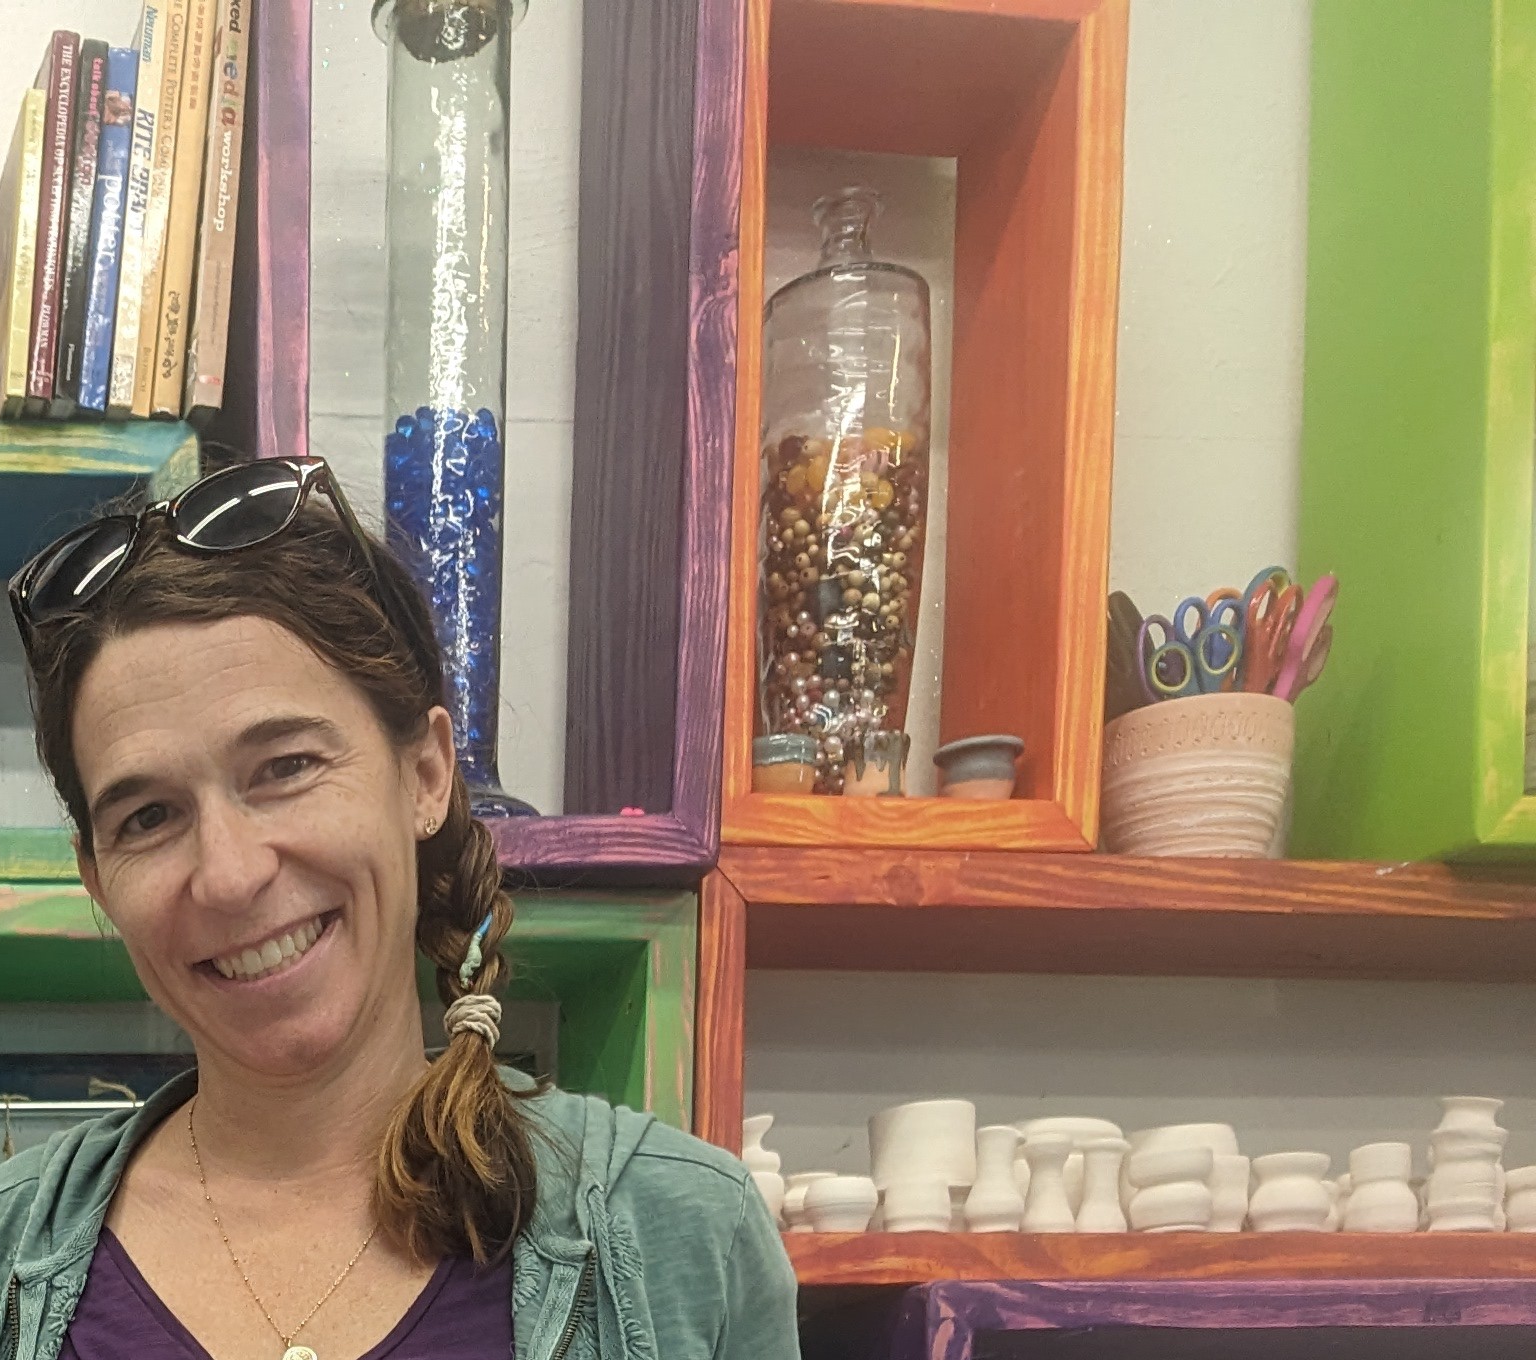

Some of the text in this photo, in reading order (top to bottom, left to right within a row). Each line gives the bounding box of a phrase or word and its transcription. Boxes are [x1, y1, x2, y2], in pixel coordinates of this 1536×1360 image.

[61, 45, 74, 66] THE
[141, 5, 159, 63] Newman
[211, 131, 233, 232] workshop
